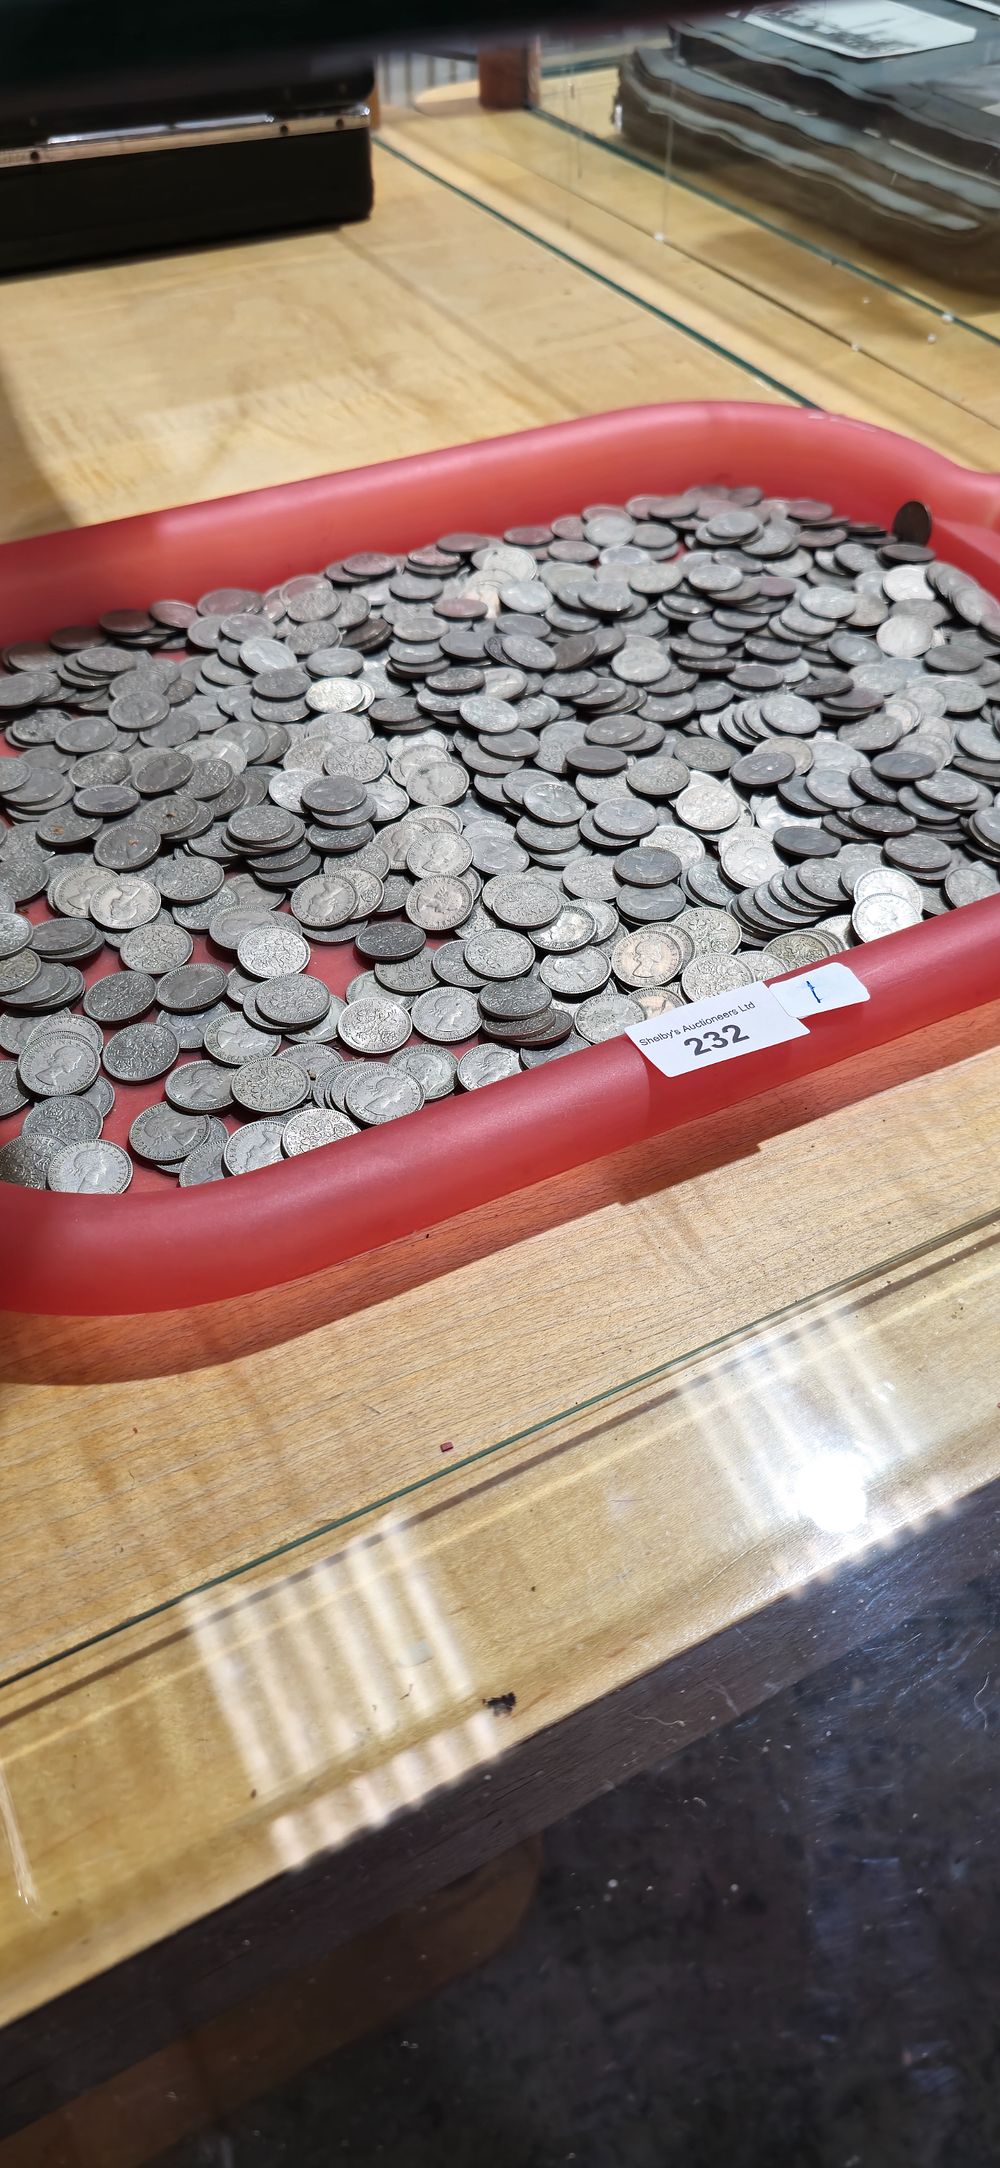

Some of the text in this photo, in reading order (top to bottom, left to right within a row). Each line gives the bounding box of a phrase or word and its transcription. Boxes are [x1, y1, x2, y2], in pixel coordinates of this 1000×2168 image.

[639, 1001, 755, 1046] Shelby's Auctioneers Ltd
[684, 1024, 750, 1056] 232
